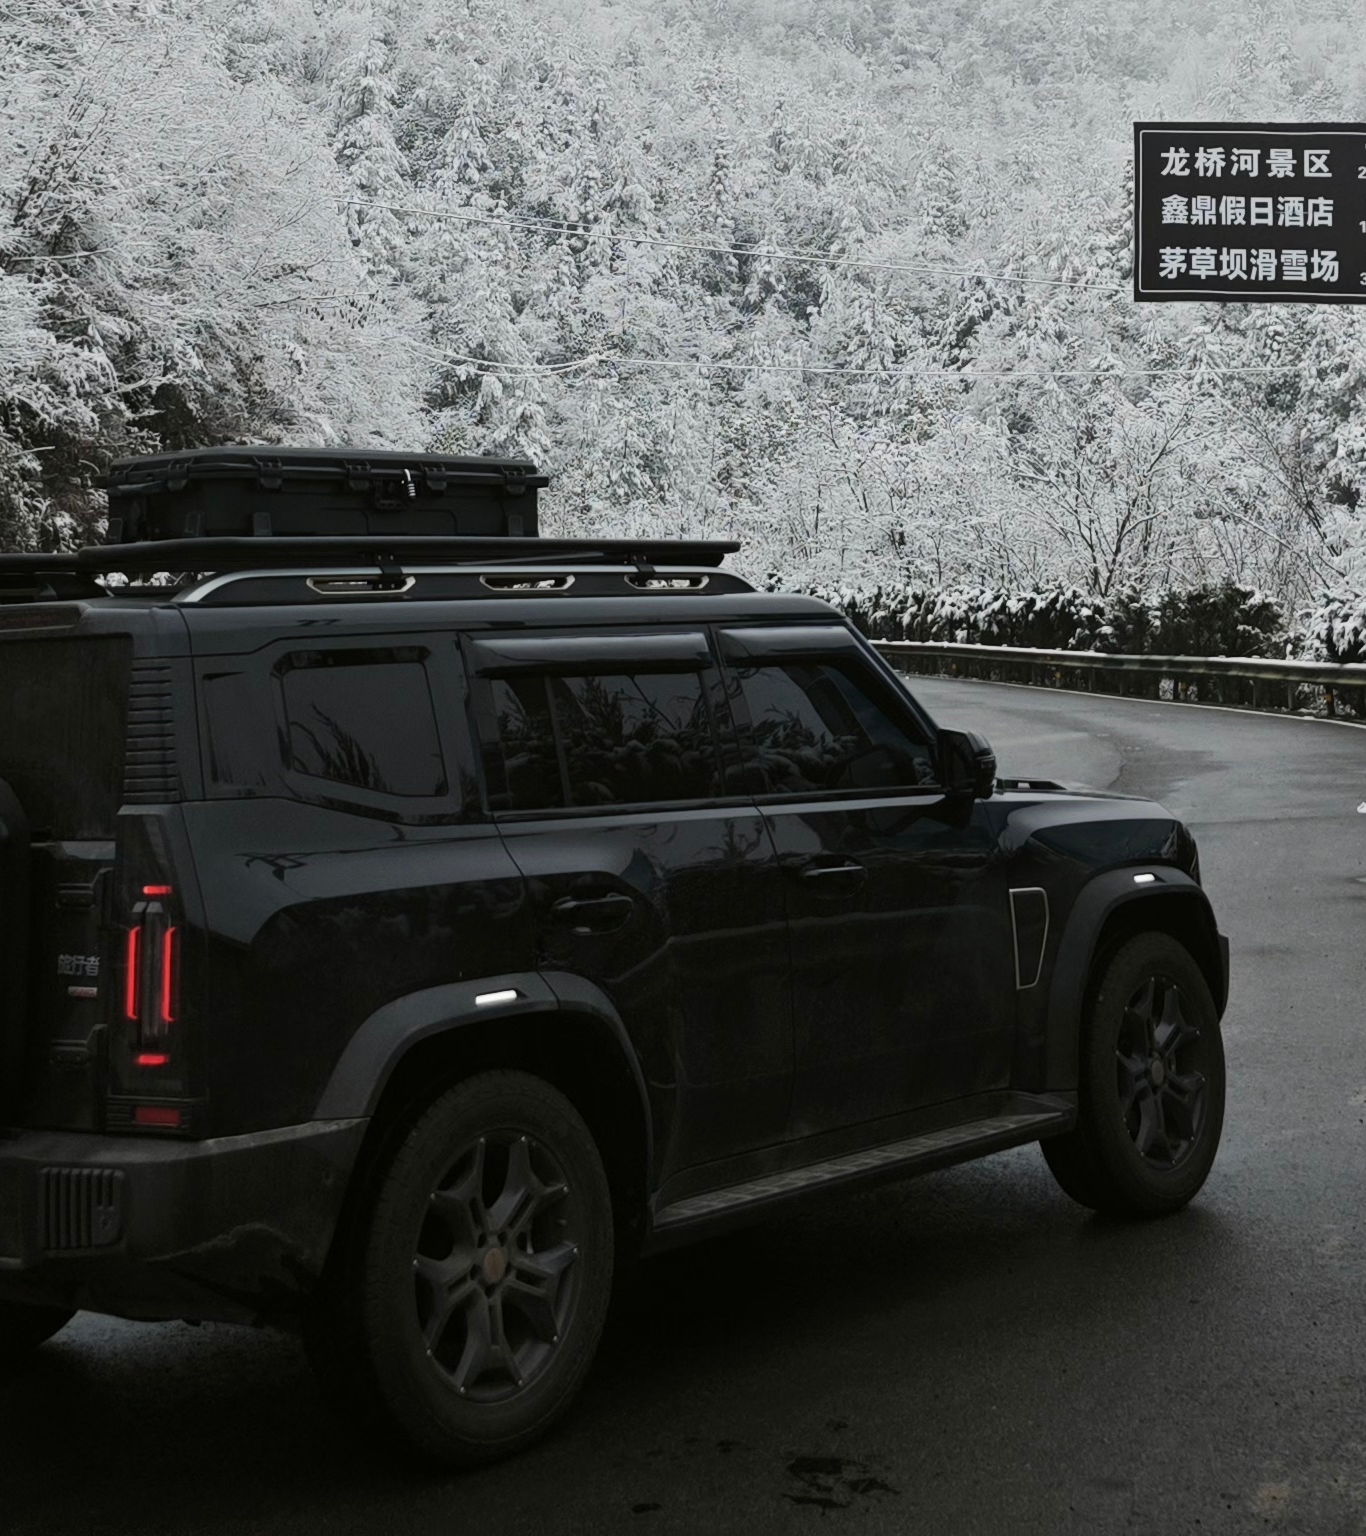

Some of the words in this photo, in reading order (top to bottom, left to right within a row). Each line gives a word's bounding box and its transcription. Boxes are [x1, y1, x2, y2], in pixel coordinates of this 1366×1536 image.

[1160, 146, 1333, 179] 龙桥河景区
[1161, 194, 1334, 227] 鑫鼎假日酒店
[1159, 246, 1339, 283] 茅草坝滑雪场
